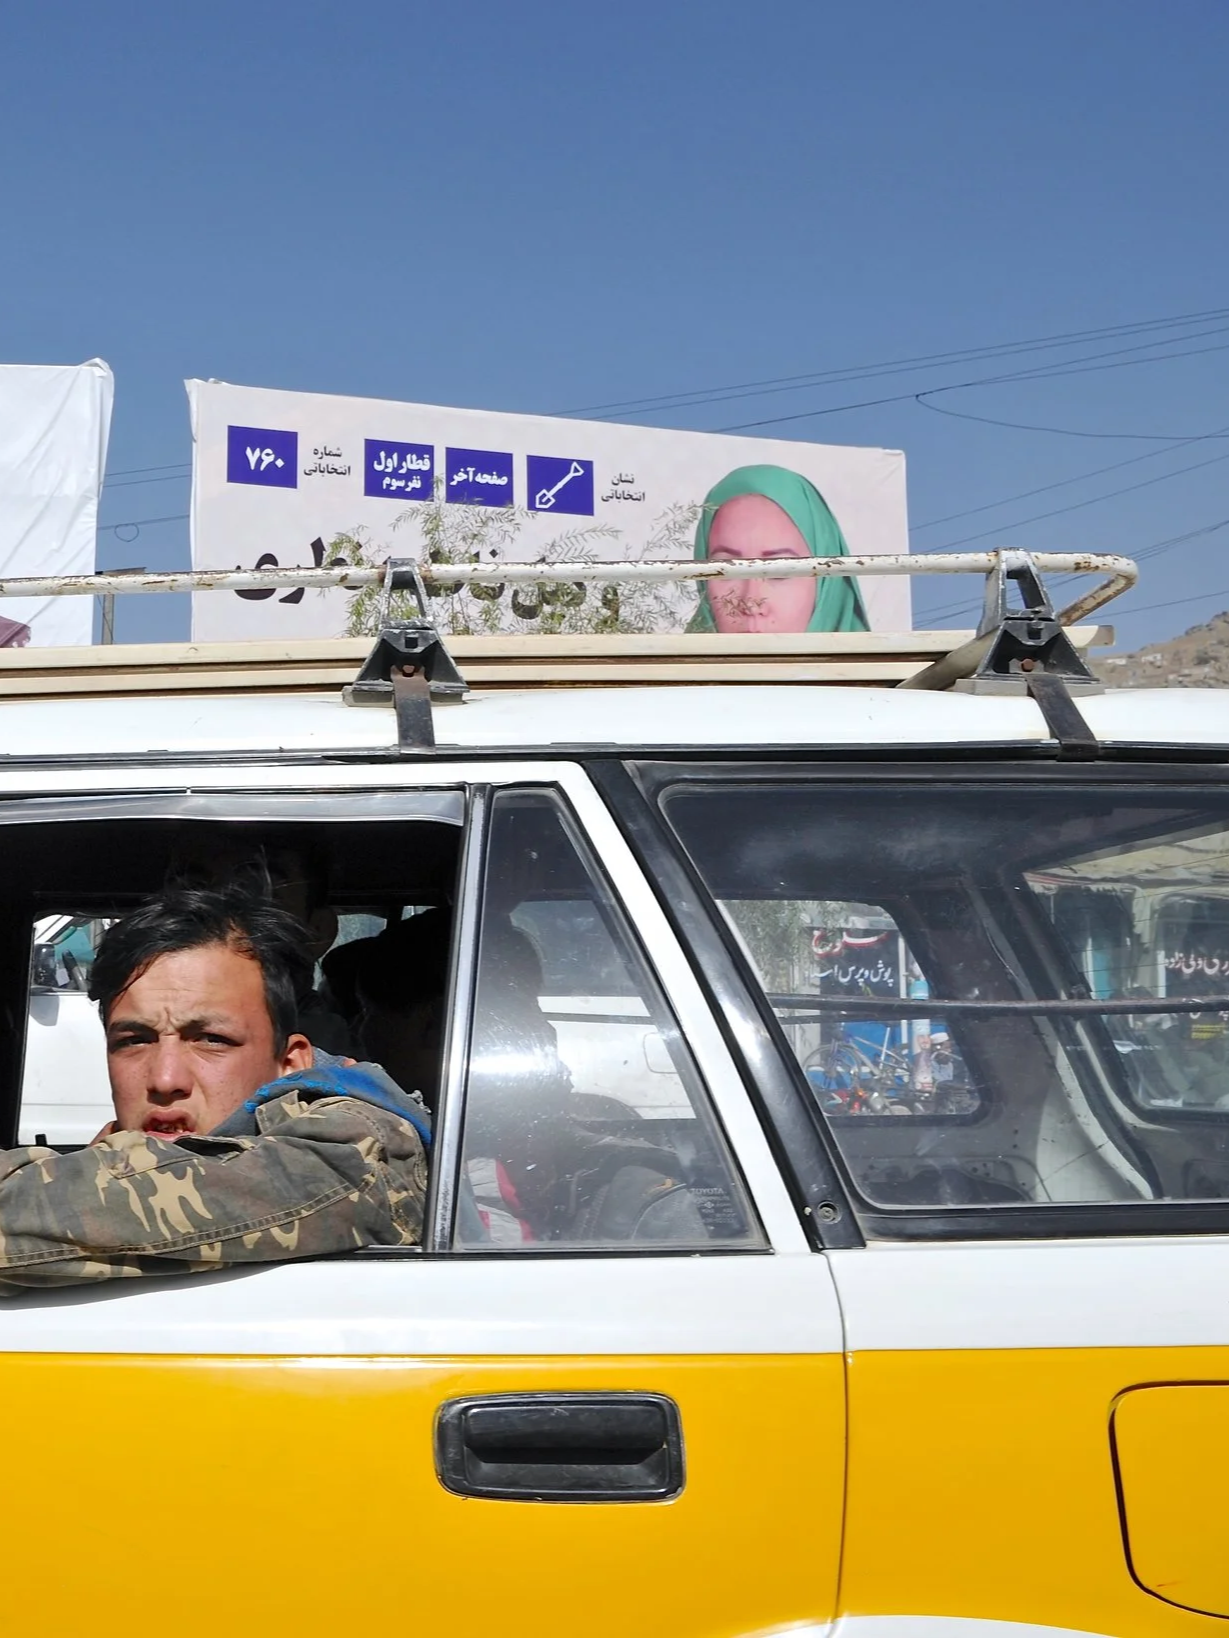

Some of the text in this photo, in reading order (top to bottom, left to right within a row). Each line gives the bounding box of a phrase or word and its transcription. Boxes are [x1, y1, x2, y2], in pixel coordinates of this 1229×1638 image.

[312, 445, 343, 459] شماره
[303, 461, 351, 477] انتخاباتی
[373, 450, 431, 473] قطار اول
[382, 475, 422, 492] نفر سوم
[449, 467, 509, 487] صفحه آخر
[611, 472, 635, 486] نشان
[600, 488, 646, 503] انتخاباتی
[691, 1187, 724, 1195] TOYOTA
